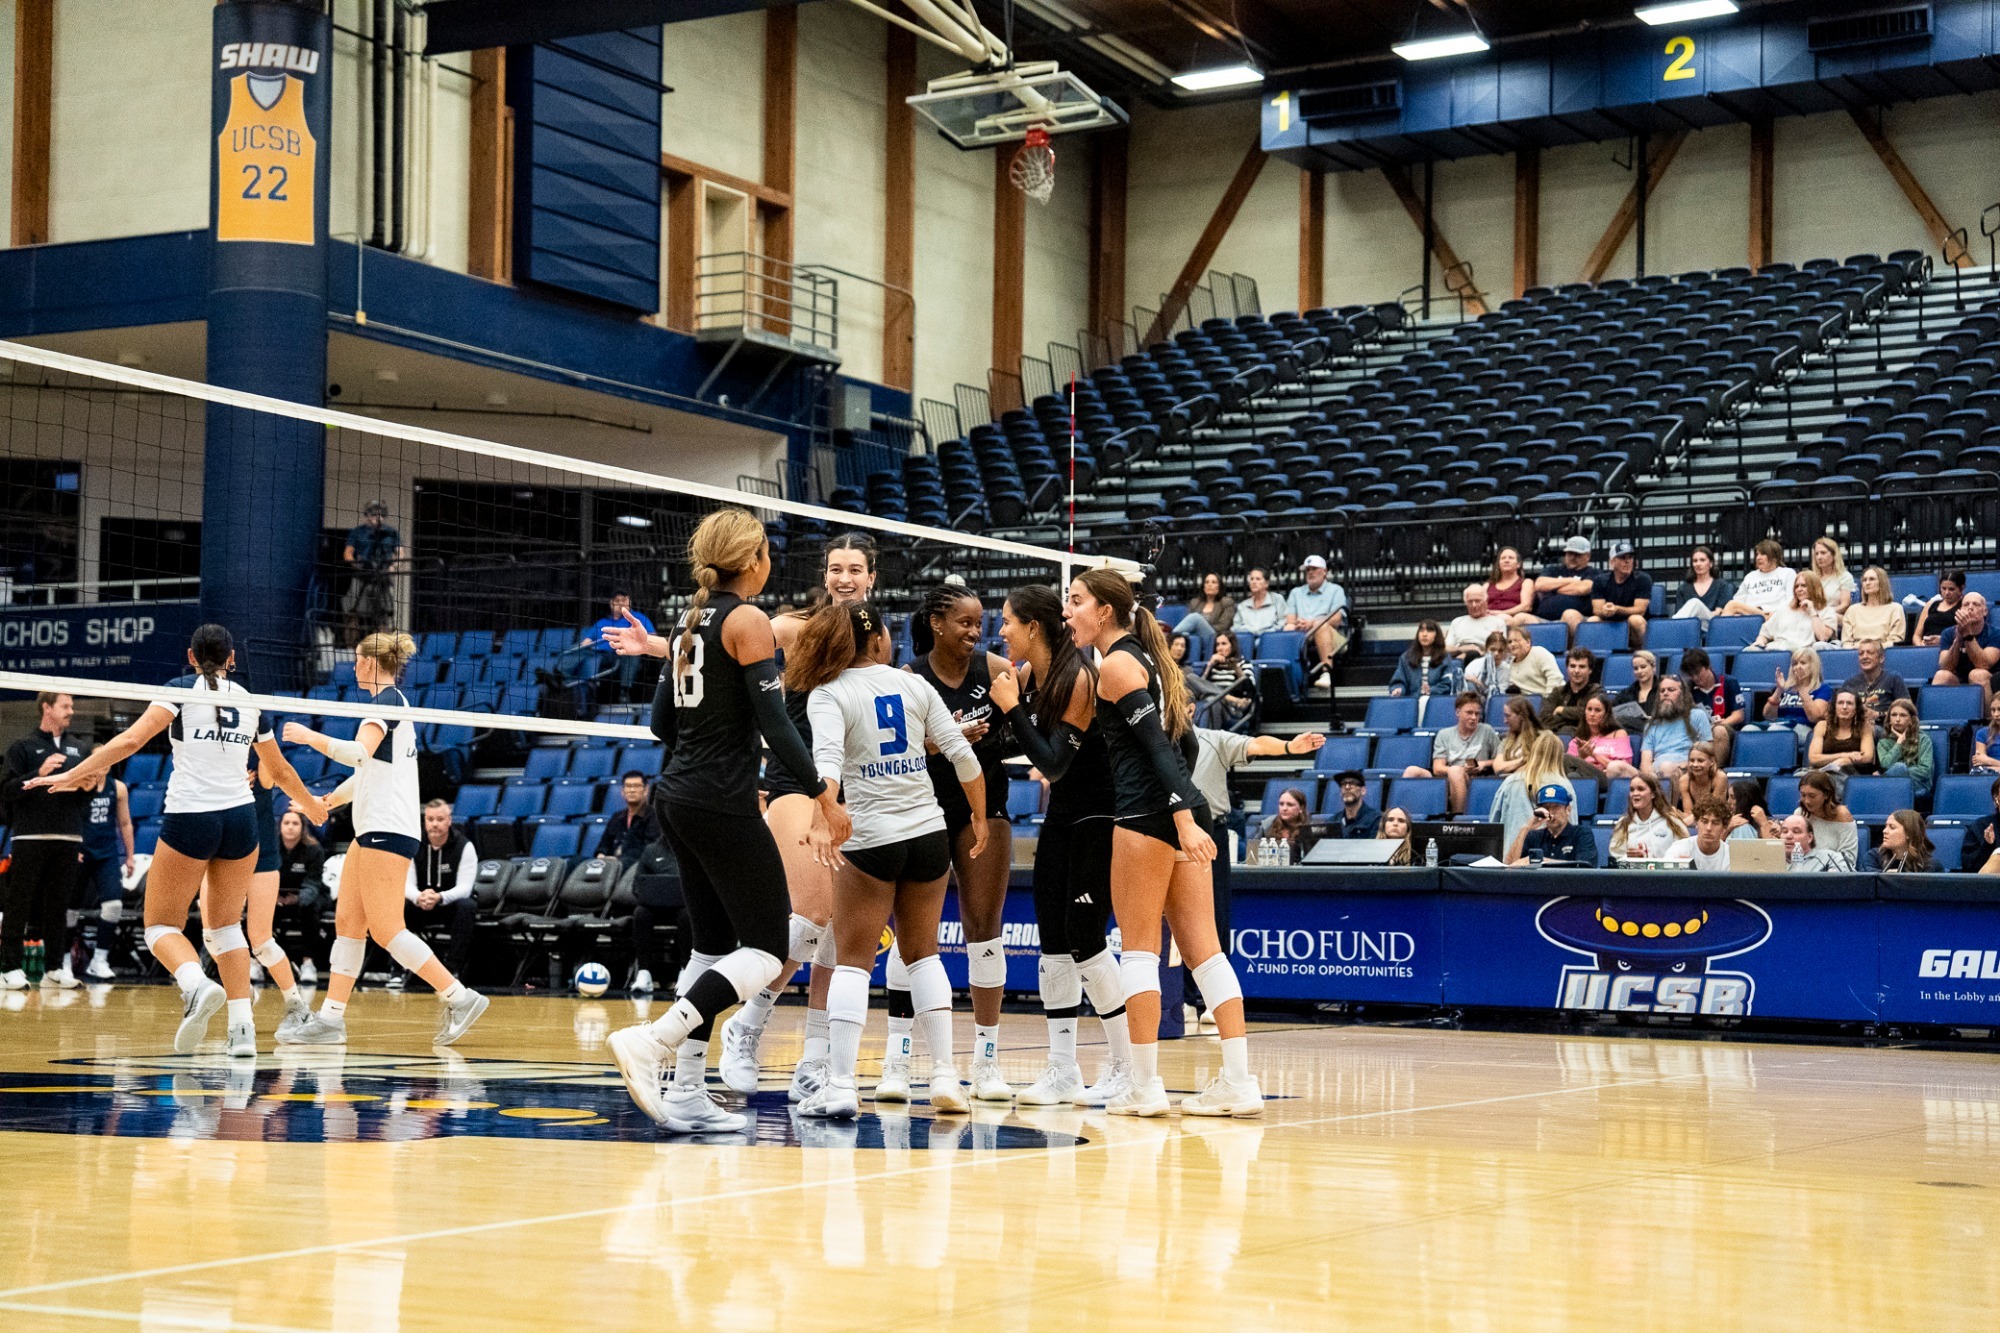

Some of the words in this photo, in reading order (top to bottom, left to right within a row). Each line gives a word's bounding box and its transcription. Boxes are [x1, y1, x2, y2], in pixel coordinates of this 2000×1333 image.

[220, 42, 320, 74] SHAW
[1663, 36, 1696, 81] 2
[1270, 91, 1290, 131] 1
[233, 125, 301, 156] UCSB
[242, 165, 288, 200] 22
[0, 620, 69, 647] CHOS
[86, 617, 155, 645] SHOP
[874, 694, 908, 756] 9
[961, 703, 991, 721] arbara
[193, 728, 252, 746] LANCERS
[91, 807, 109, 824] 22
[1247, 964, 1255, 973] A
[1258, 963, 1289, 975] FUND
[1292, 964, 1315, 975] FOR
[1318, 965, 1414, 978] OPPORTUNITIES
[1563, 973, 1747, 1016] UCSB
[1920, 991, 1931, 1000] In
[1934, 991, 1951, 1000] the
[1954, 991, 1985, 1003] Lobby
